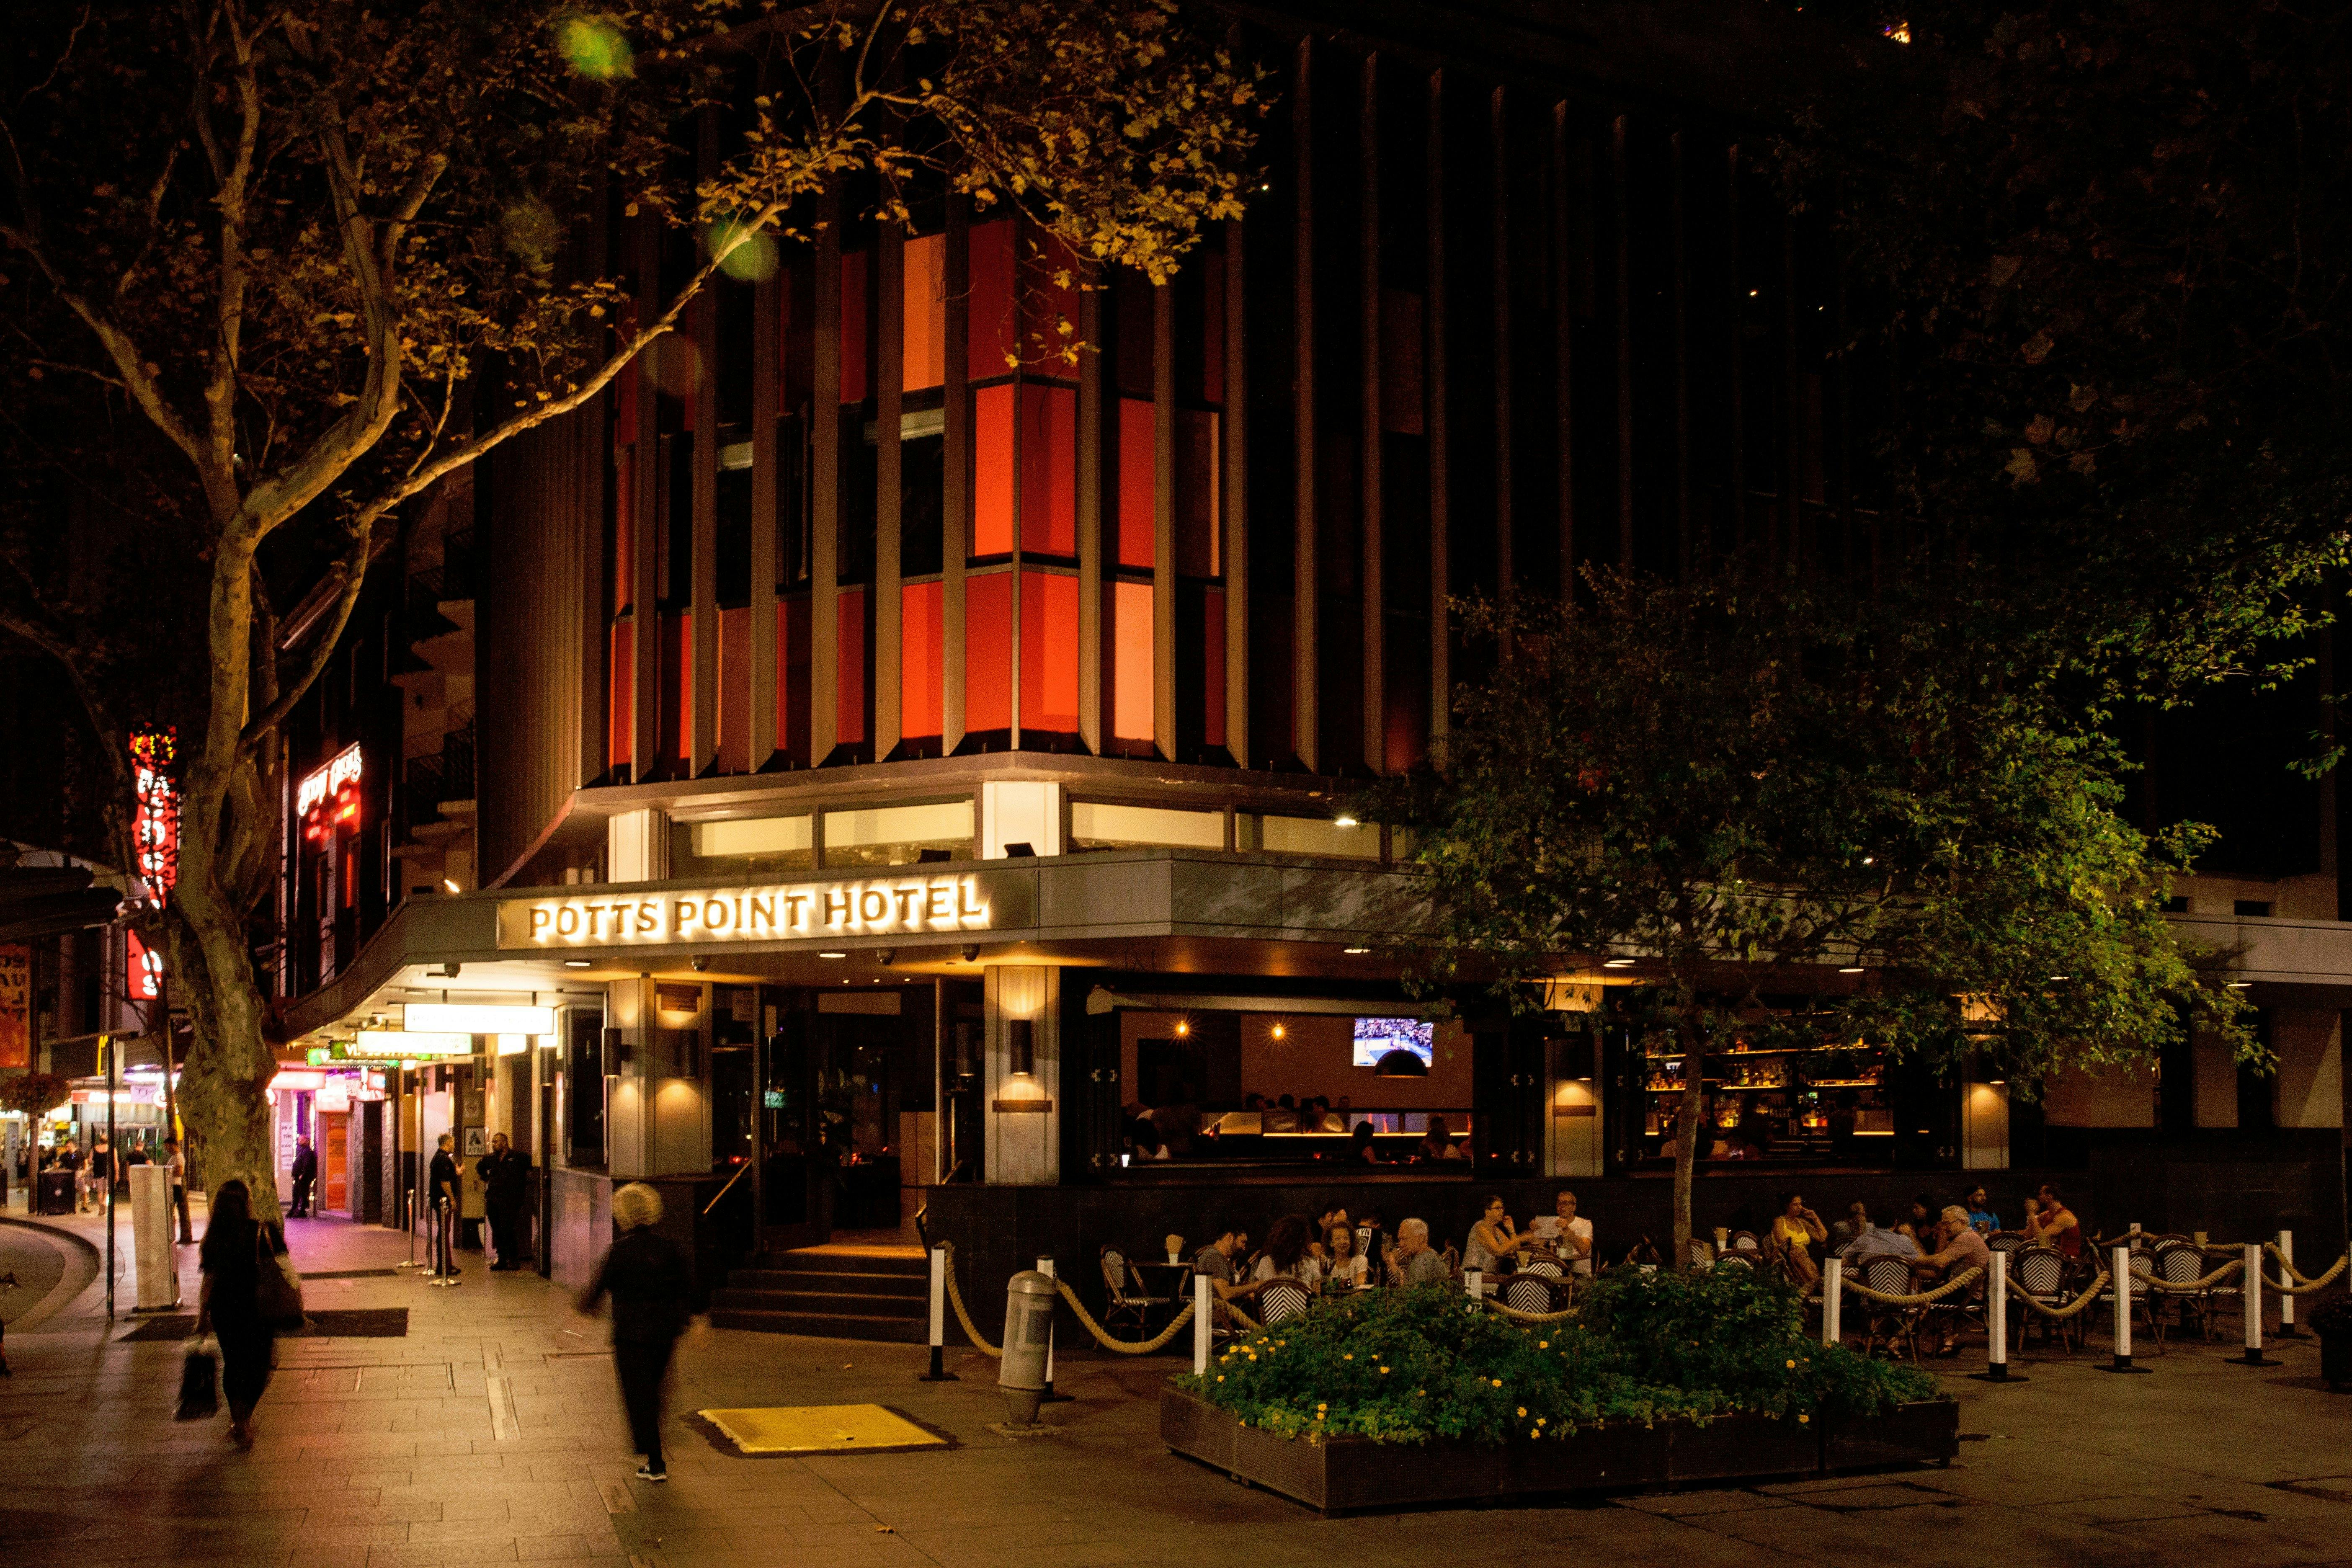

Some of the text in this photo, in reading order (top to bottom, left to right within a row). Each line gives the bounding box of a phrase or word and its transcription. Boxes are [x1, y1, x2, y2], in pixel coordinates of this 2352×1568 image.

[529, 885, 982, 938] POTTS POINT HOTEL
